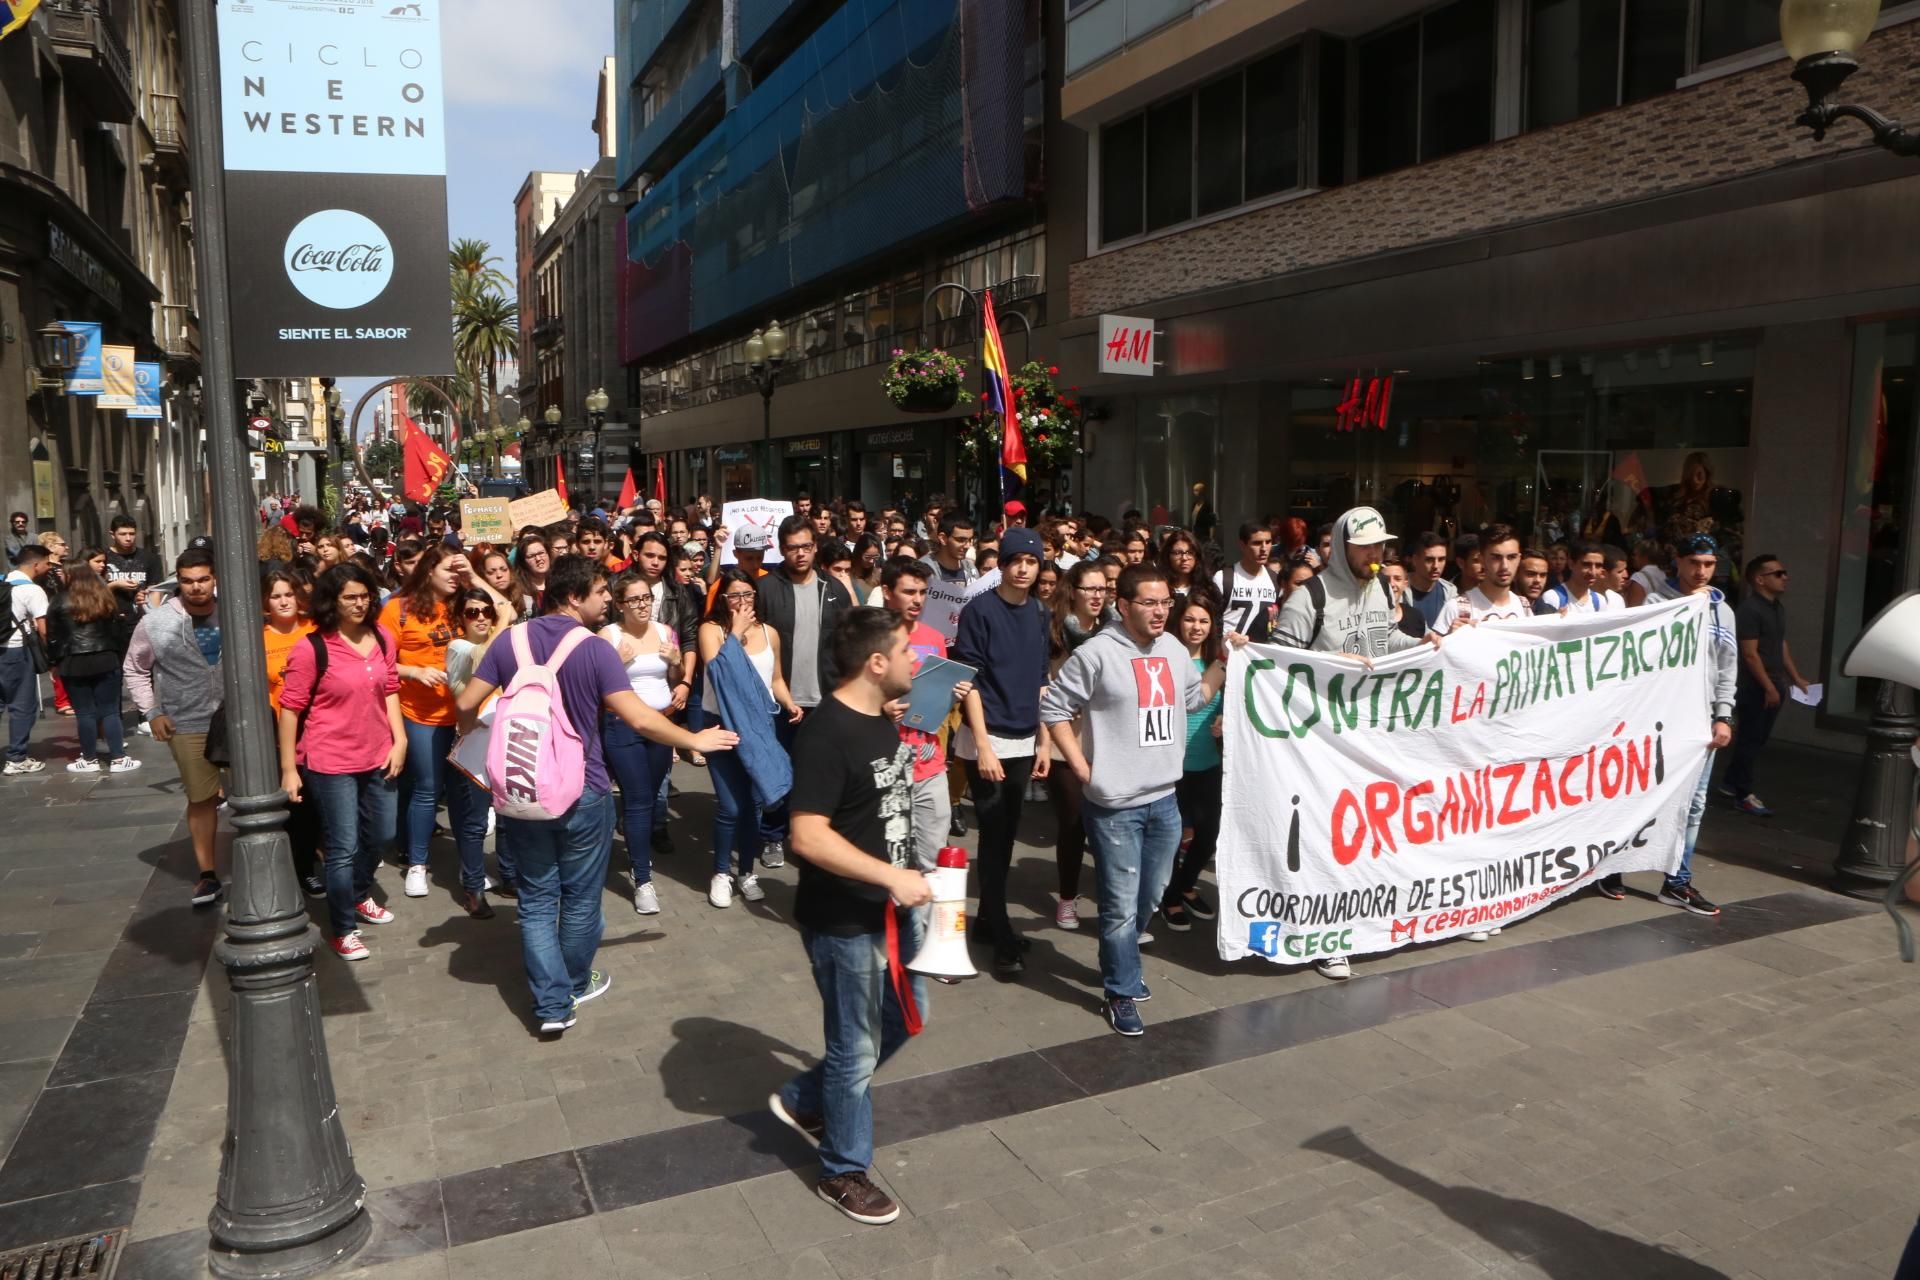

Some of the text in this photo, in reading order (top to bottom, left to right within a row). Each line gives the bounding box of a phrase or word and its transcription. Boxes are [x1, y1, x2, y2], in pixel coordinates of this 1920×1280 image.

[242, 40, 422, 69] CICLO
[243, 75, 424, 104] NEO
[243, 111, 424, 138] WESTERN
[278, 327, 331, 341] SIENTE
[334, 328, 353, 340] EL
[1105, 326, 1152, 365] H&M
[1335, 374, 1395, 432] H&M
[1232, 587, 1253, 598] NEW
[1244, 606, 1703, 739] CONTRA LA PRIVATIZACIÓN
[1144, 709, 1172, 742] ALI
[506, 719, 539, 803] NIKE
[1237, 885, 1397, 926] COORDINADORA
[1406, 877, 1437, 912] DE
[1439, 846, 1581, 907] ESTUDIANTES
[1283, 928, 1353, 958] CEGC
